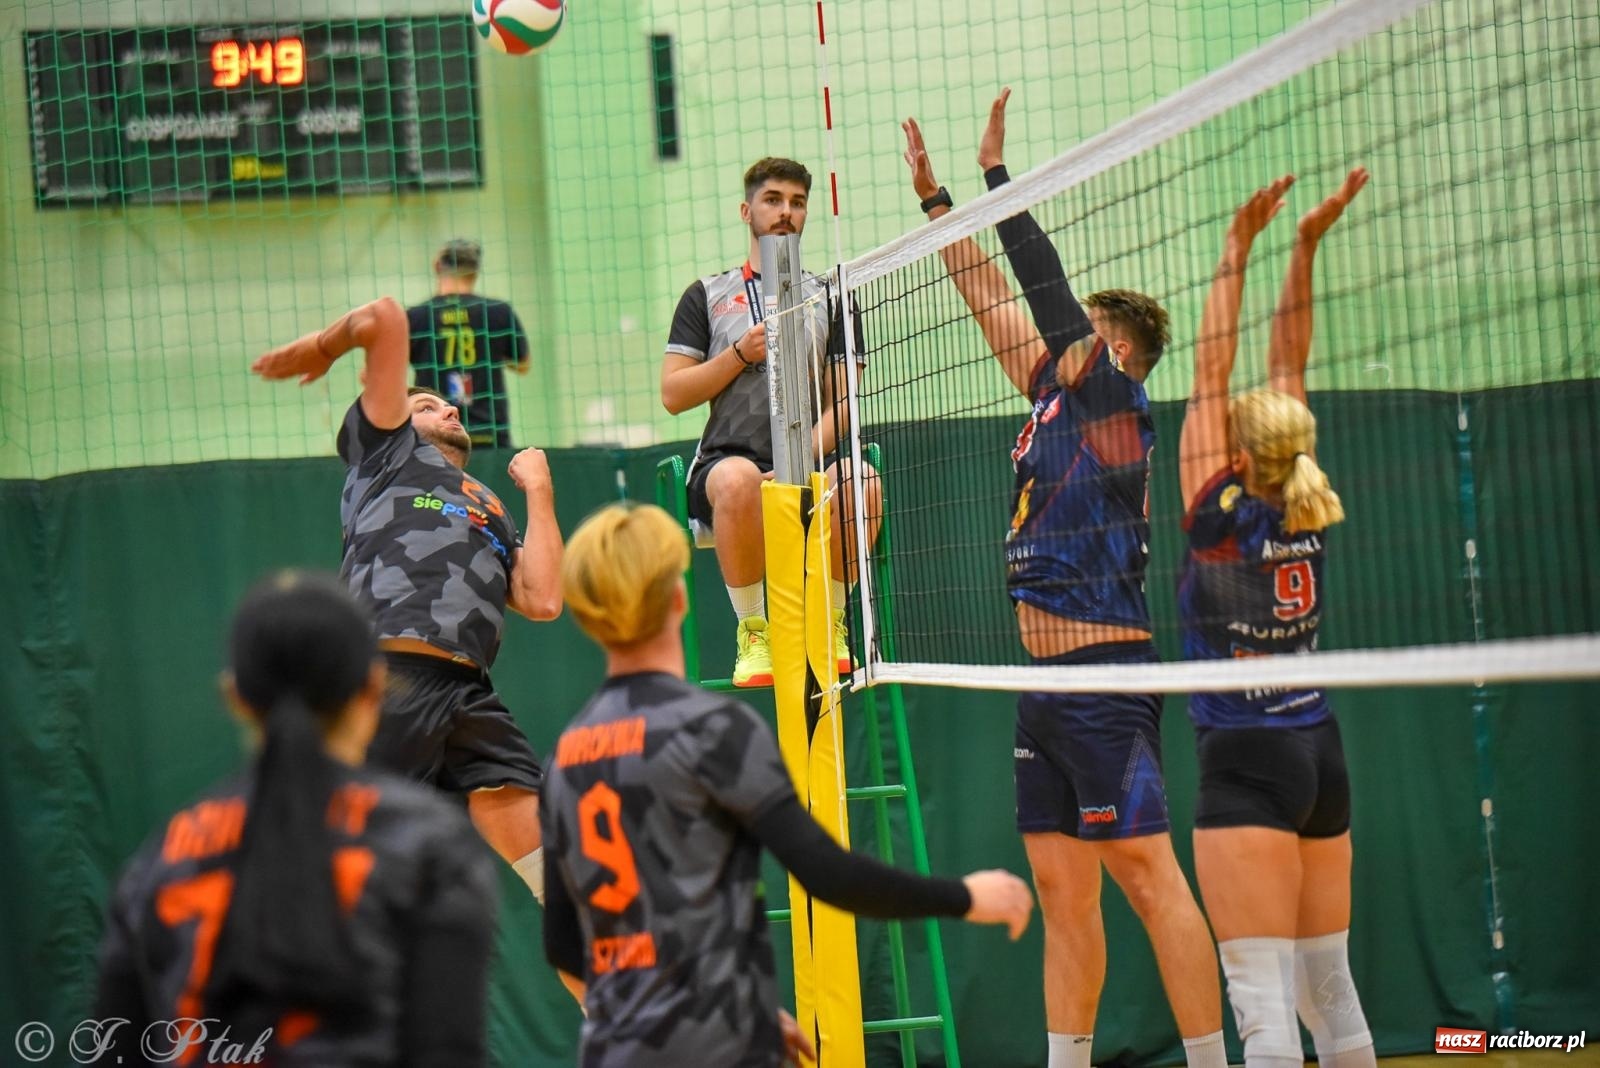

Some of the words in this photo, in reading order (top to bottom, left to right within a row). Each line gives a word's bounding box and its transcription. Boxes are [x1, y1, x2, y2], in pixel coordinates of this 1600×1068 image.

[211, 38, 304, 87] 9:49
[440, 327, 476, 367] 78
[1273, 560, 1317, 621] 9
[577, 780, 641, 914] 9
